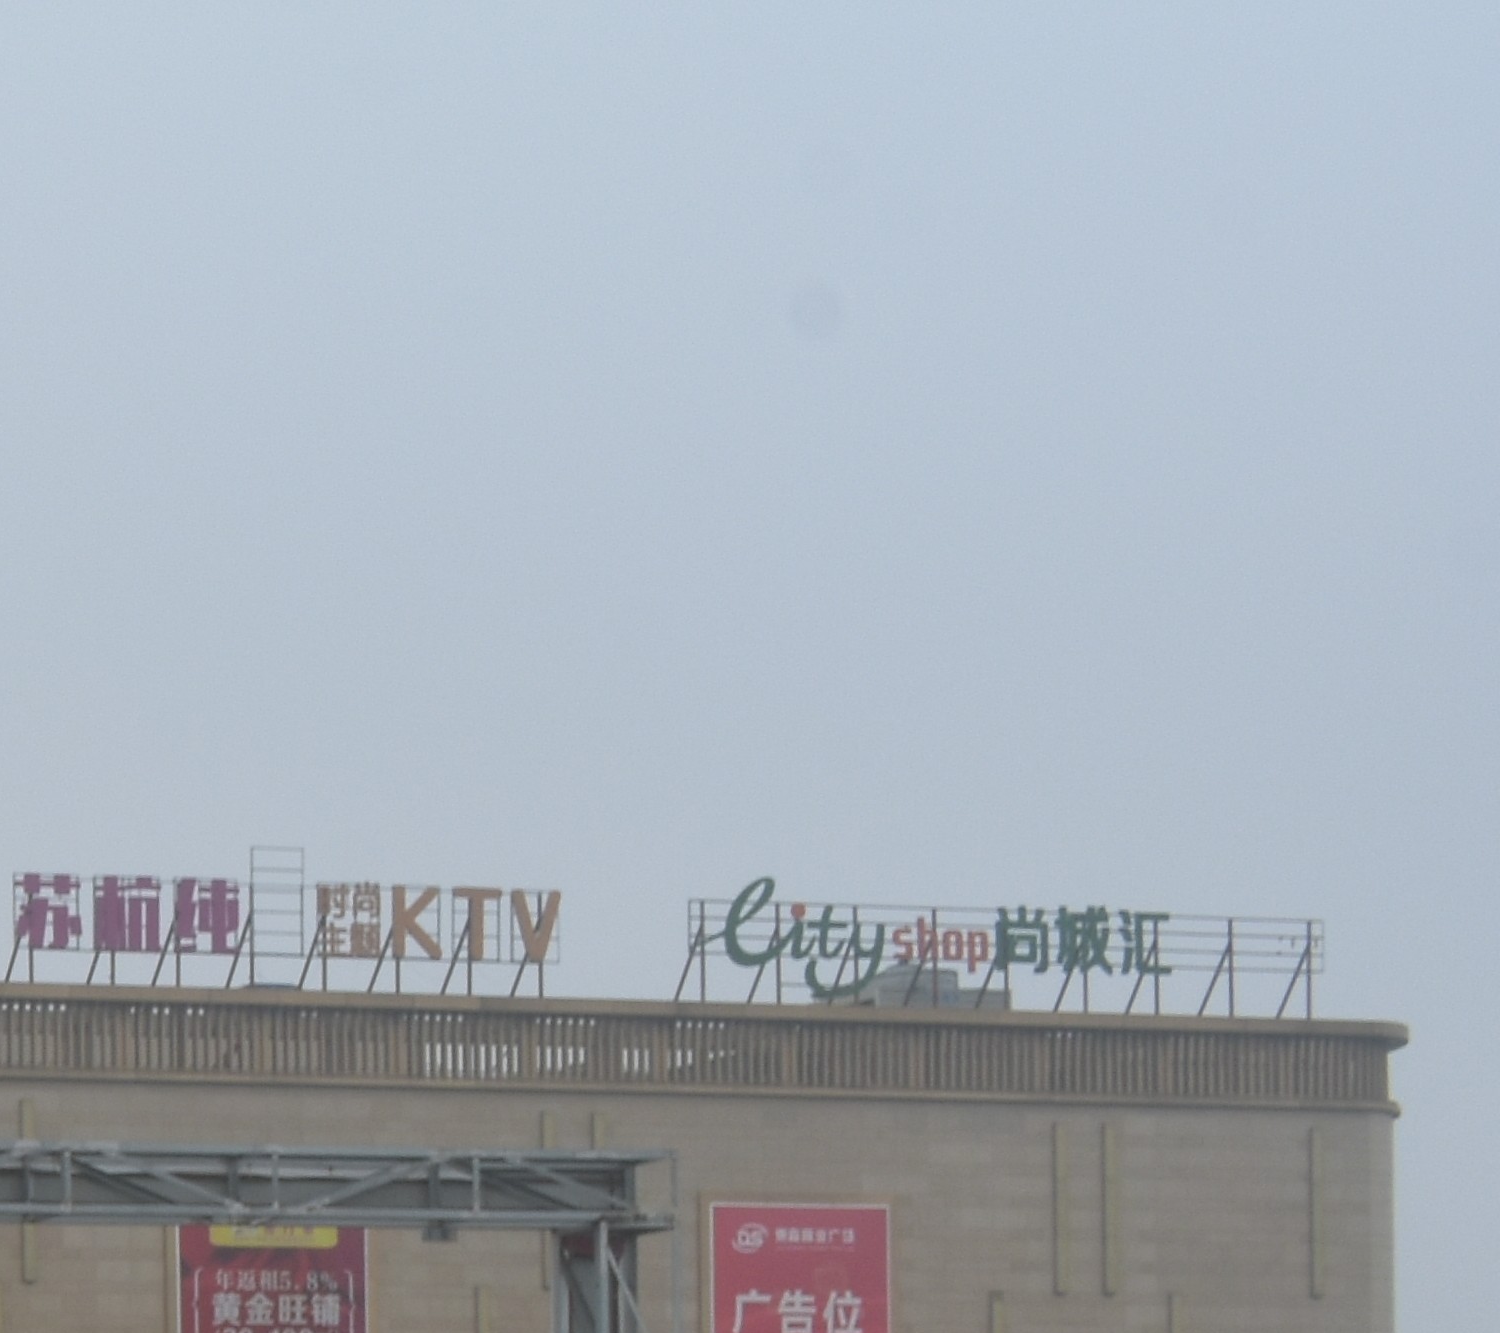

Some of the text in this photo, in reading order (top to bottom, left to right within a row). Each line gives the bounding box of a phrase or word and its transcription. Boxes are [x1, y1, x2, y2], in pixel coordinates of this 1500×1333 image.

[391, 885, 562, 961] KTV
[705, 876, 1173, 998] City shop 尚城汇
[212, 1292, 341, 1328] 黄金旺铺
